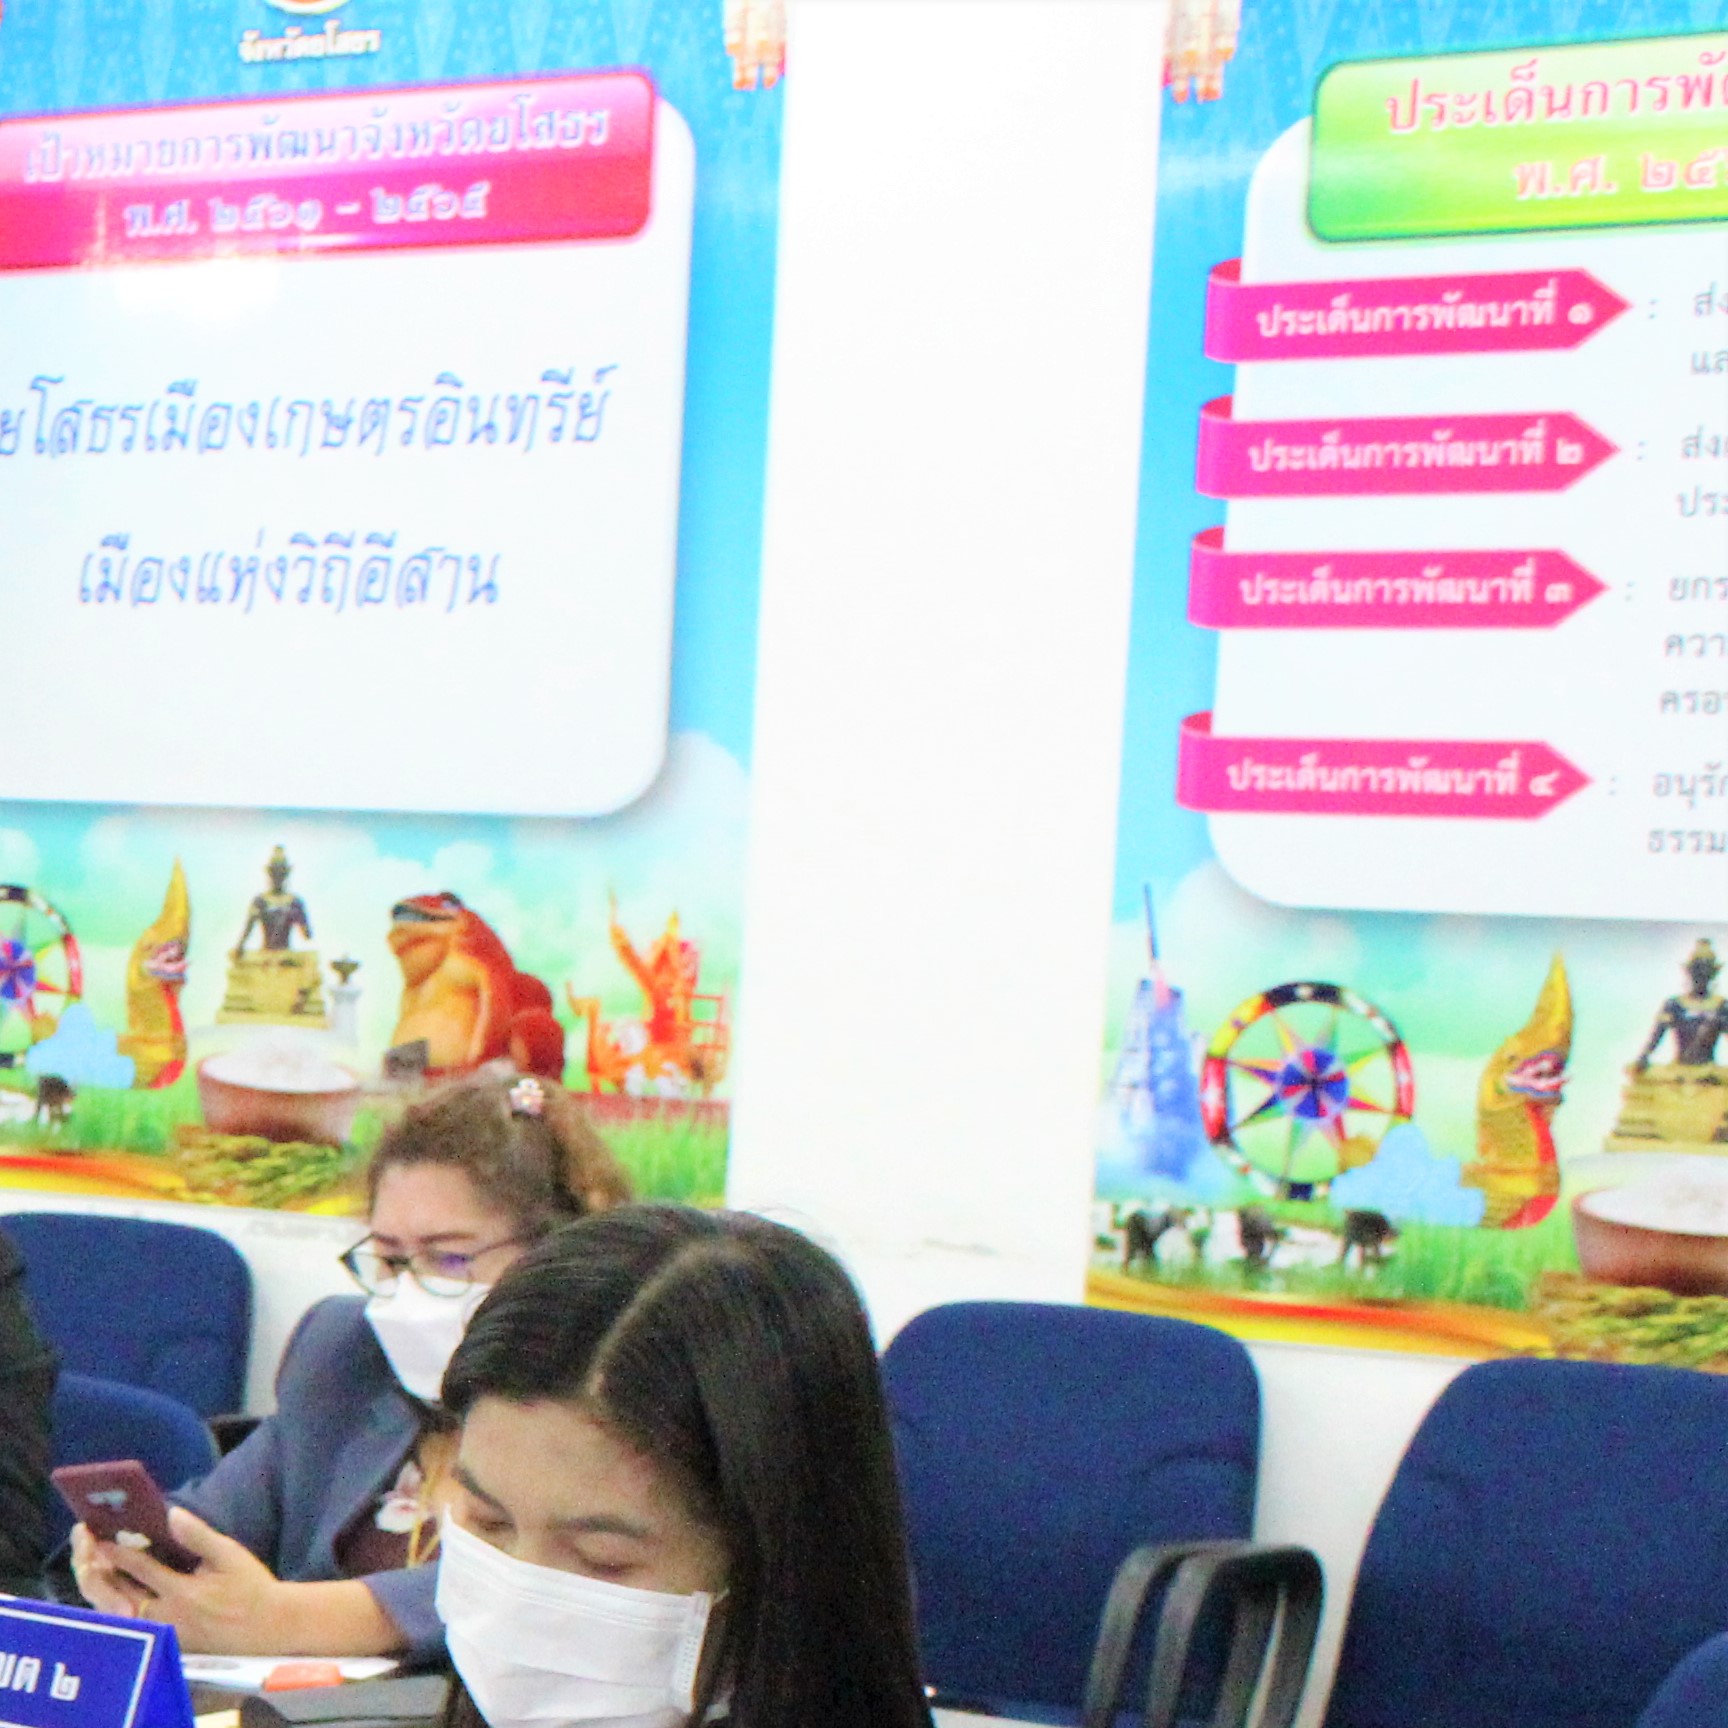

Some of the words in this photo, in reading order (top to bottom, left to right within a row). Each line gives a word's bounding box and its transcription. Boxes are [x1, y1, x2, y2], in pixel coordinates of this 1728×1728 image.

[1385, 50, 1728, 133] ประเด็นการพั
[23, 94, 611, 182] เป้าหมายการพัฒนาจังหวัดยโสธร
[1515, 154, 1618, 200] พ.ศ.
[1639, 146, 1728, 192] ๒๕
[123, 198, 198, 238] พ.ศ.
[1256, 278, 1558, 337] ประเด็นการพัฒนาที่
[1566, 301, 1595, 325] ๑
[1248, 419, 1547, 472] ประเด็นการพัฒนาที่
[1554, 437, 1585, 465] ๒
[78, 528, 500, 615] เมืองแห่งวิถีอีสาน
[1239, 558, 1536, 605] ประเด็นการพัฒนาที่
[1226, 748, 1521, 794] ประเด็นการพัฒนาที่
[49, 1660, 82, 1701] ๒
